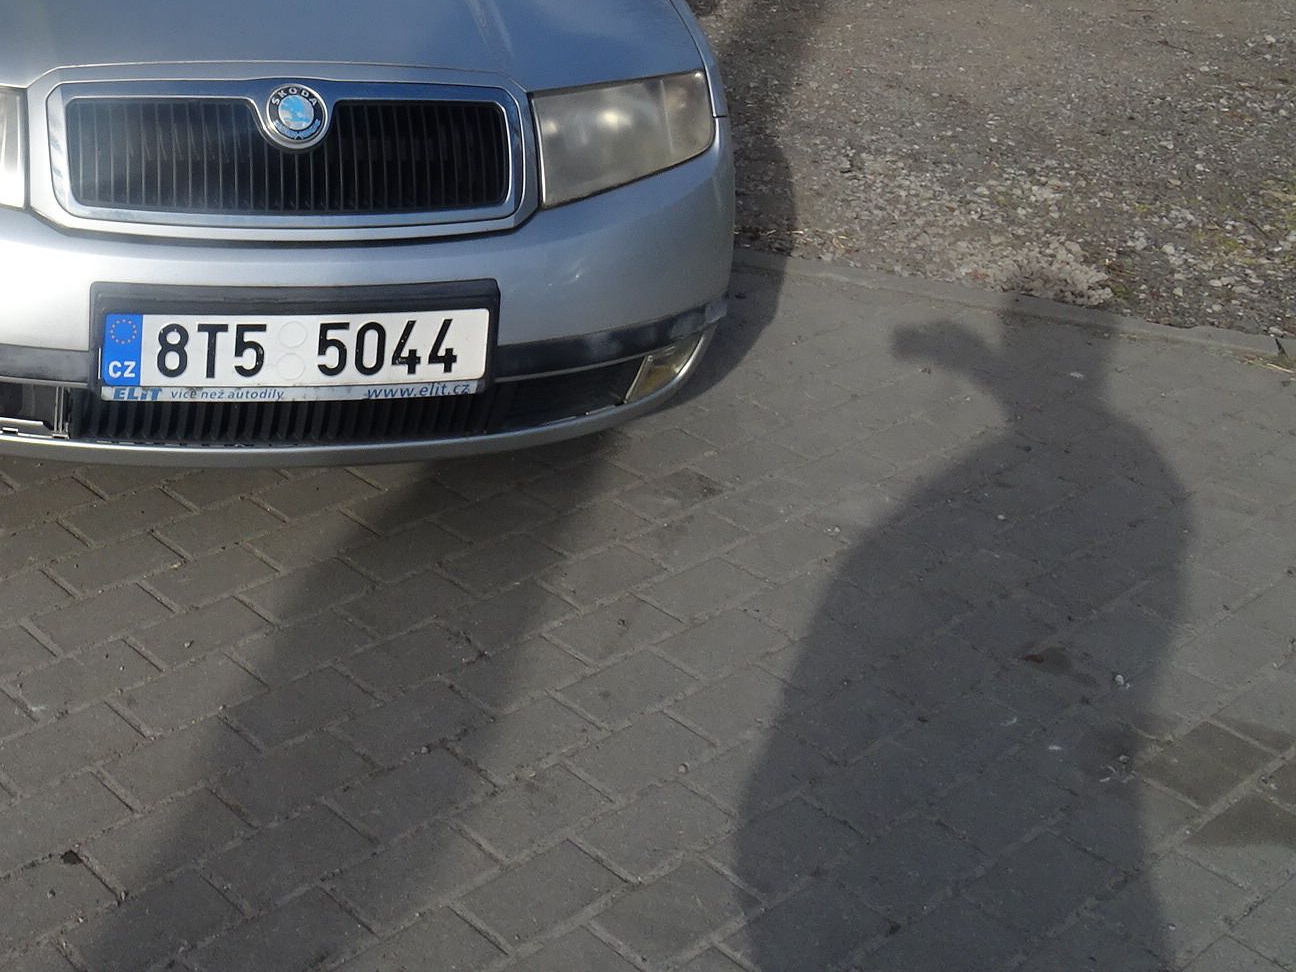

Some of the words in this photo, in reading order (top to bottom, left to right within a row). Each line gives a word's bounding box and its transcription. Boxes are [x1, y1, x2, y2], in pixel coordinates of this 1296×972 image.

[156, 323, 268, 379] 8T5
[317, 318, 458, 377] 5044
[108, 360, 136, 379] CZ
[367, 383, 470, 399] www.elit.cz
